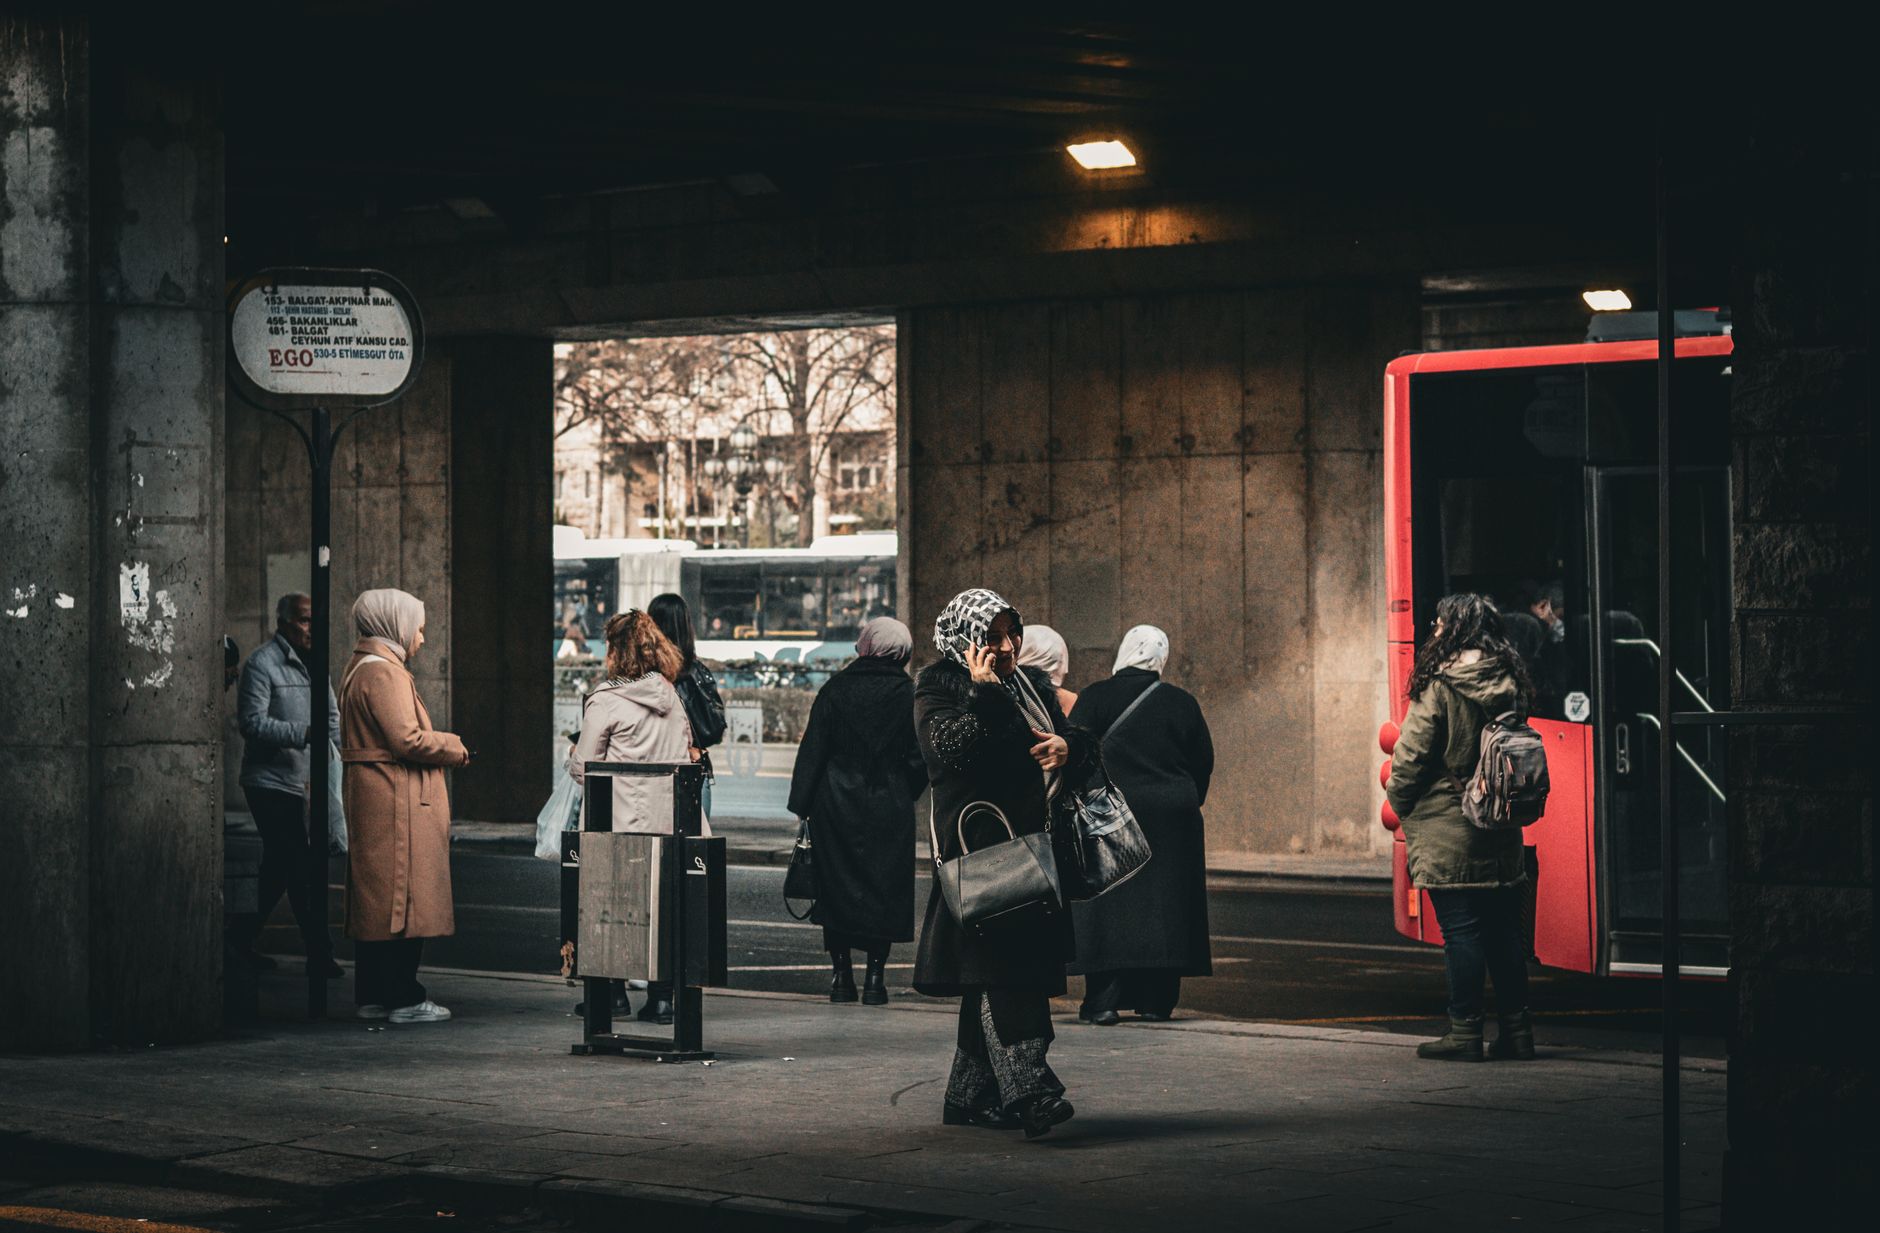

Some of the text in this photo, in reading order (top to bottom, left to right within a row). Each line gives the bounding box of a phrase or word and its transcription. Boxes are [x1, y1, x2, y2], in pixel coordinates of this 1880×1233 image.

[264, 296, 395, 307] 153- BALGAT-AKPINAR MAH.
[266, 316, 358, 327] 456- BAKANLIKLAR
[268, 326, 329, 336] 481- BALGAT
[291, 336, 409, 347] CEYHUN ATIF KANSU CAD.
[268, 348, 314, 368] EGO
[313, 348, 337, 359] 530-5
[339, 347, 386, 360] ETİMESGUT
